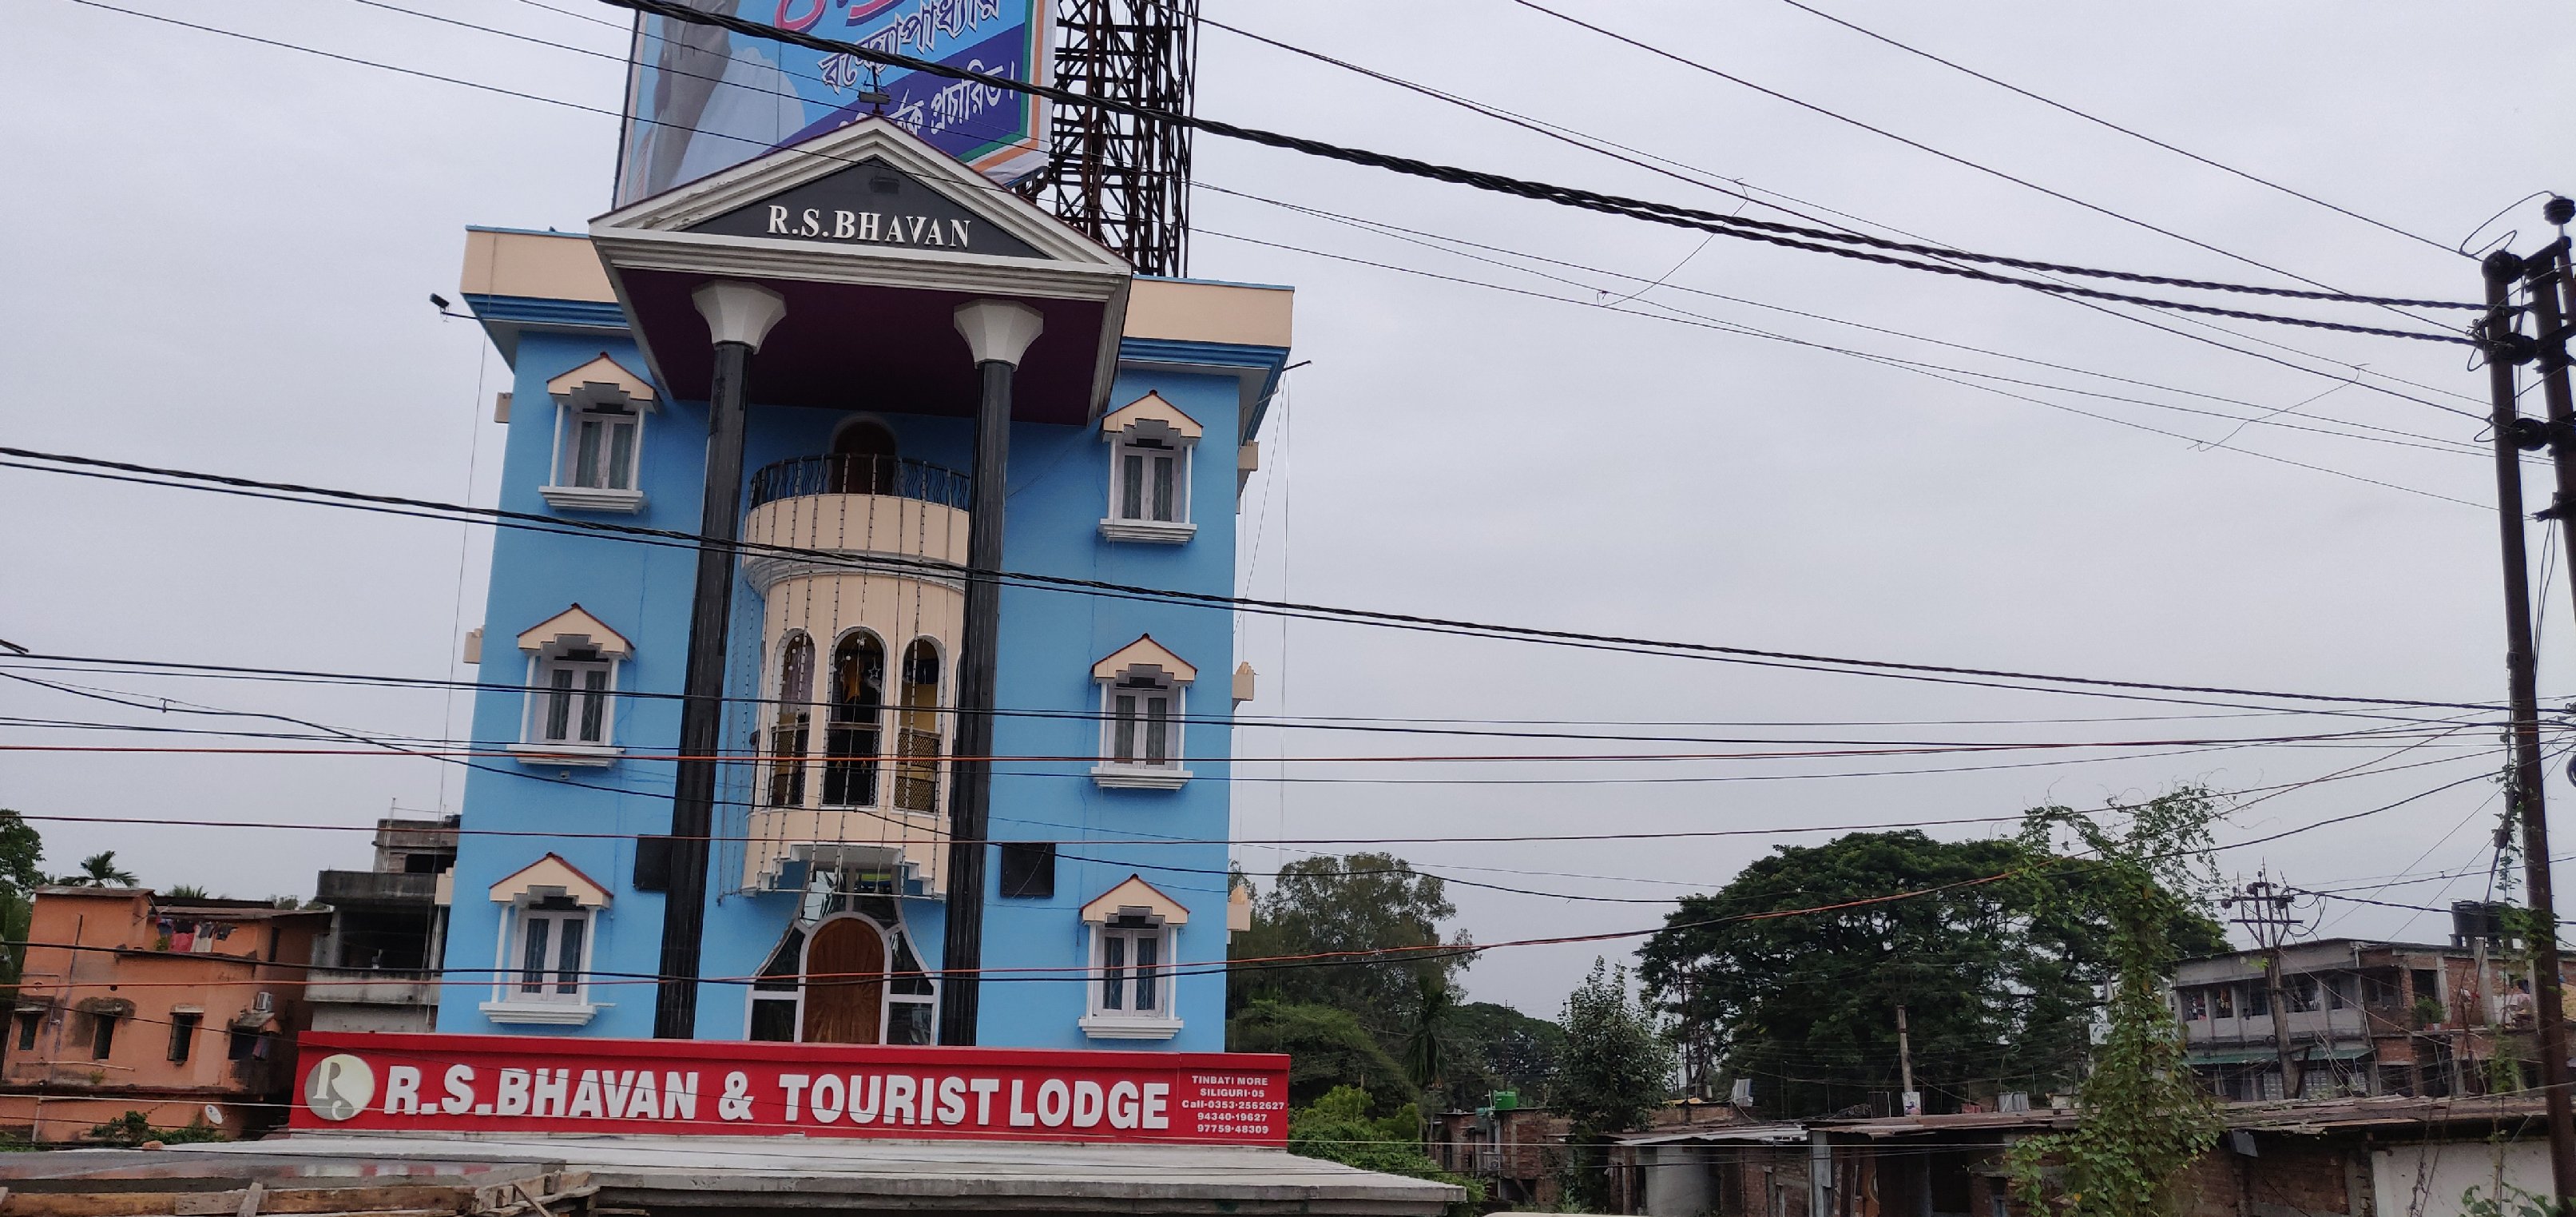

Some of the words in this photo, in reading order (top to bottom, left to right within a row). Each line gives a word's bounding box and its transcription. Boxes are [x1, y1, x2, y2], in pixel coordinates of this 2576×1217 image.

[767, 205, 971, 249] R.S.BHAVAN
[383, 1064, 698, 1120] R.S.BHAVAN
[718, 1071, 754, 1120] &
[778, 1073, 999, 1124] TOURIST
[1009, 1079, 1169, 1129] LODGE
[1192, 1076, 1234, 1084] TINBATI
